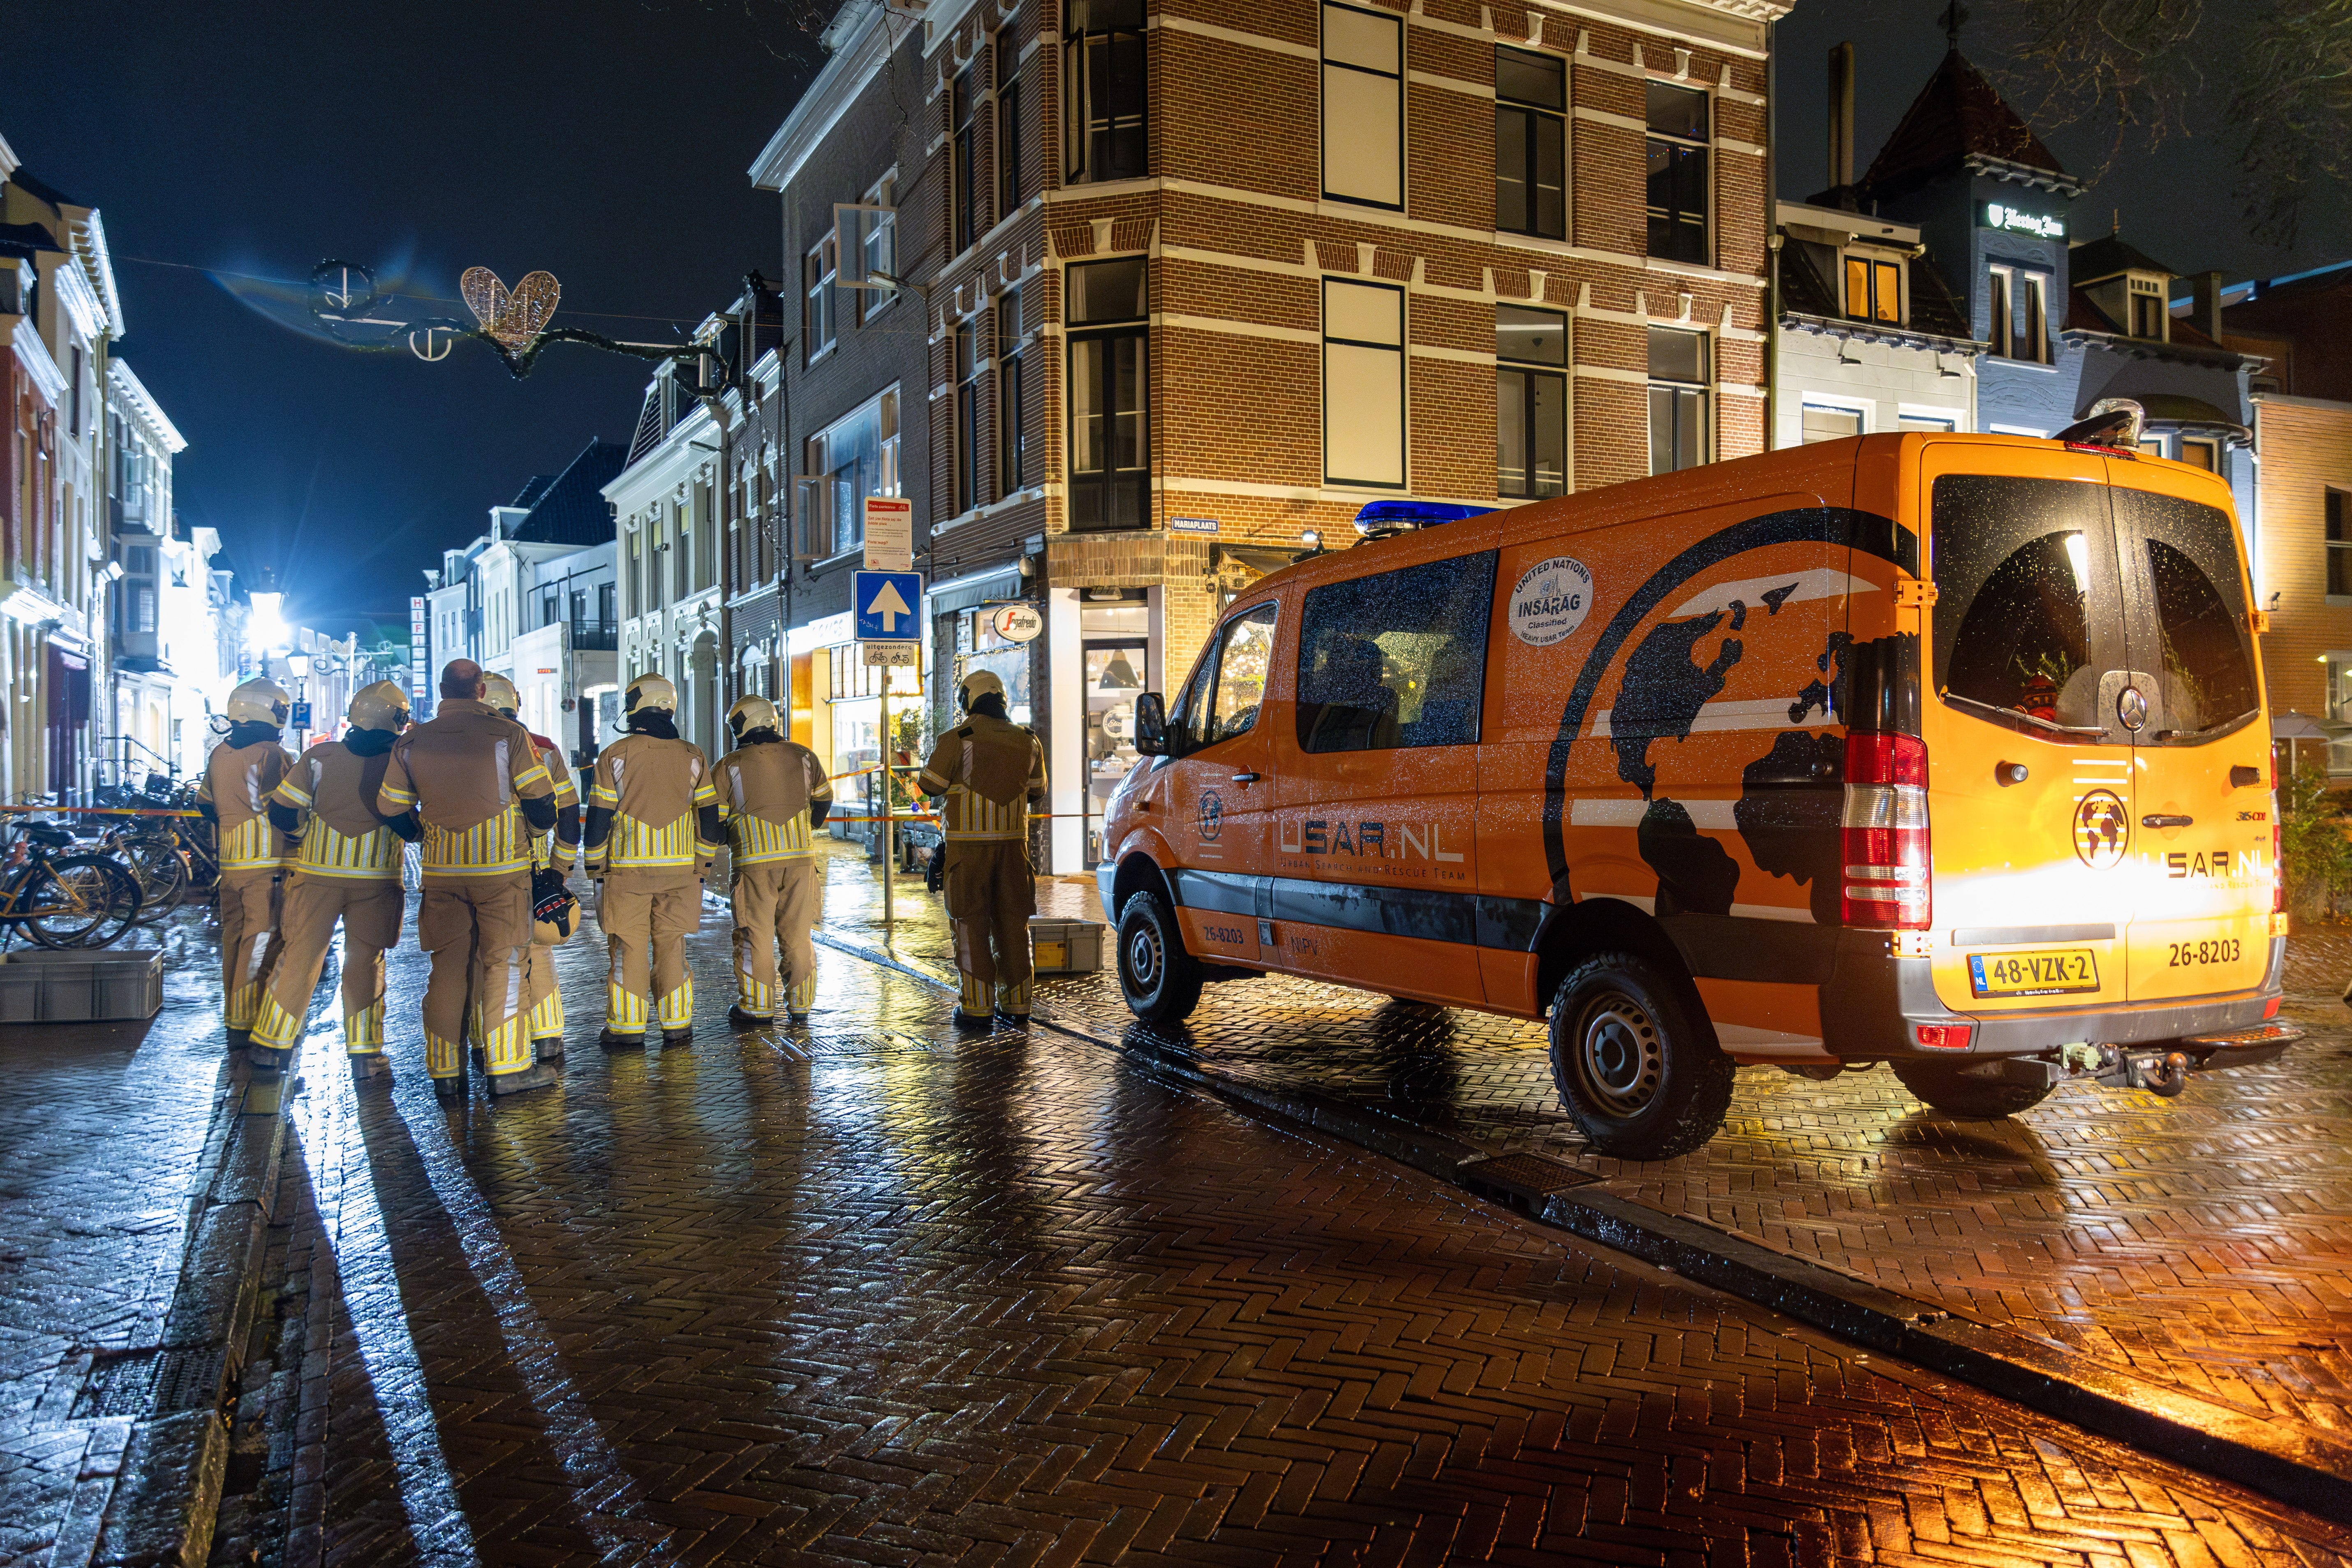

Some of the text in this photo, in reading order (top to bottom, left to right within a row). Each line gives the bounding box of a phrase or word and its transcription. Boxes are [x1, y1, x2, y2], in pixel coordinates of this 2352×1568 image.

[1175, 520, 1216, 530] MARIAPLAATS
[1516, 560, 1590, 594] UNITED NATIONS
[1519, 594, 1580, 617] INSARAG
[1528, 617, 1567, 629] Classified
[1521, 631, 1539, 643] HEAVY
[1280, 820, 1464, 863] USAR.NL
[1281, 857, 1310, 868] URBAN
[1385, 865, 1426, 878] RESCUE
[1434, 868, 1465, 881] TEAM
[1203, 926, 1244, 944] 26-8203
[1291, 936, 1317, 956] NIPV
[2169, 939, 2240, 967] 26-8203
[1994, 956, 2089, 984] 48-VZK-2
[1975, 977, 1986, 985] NL
